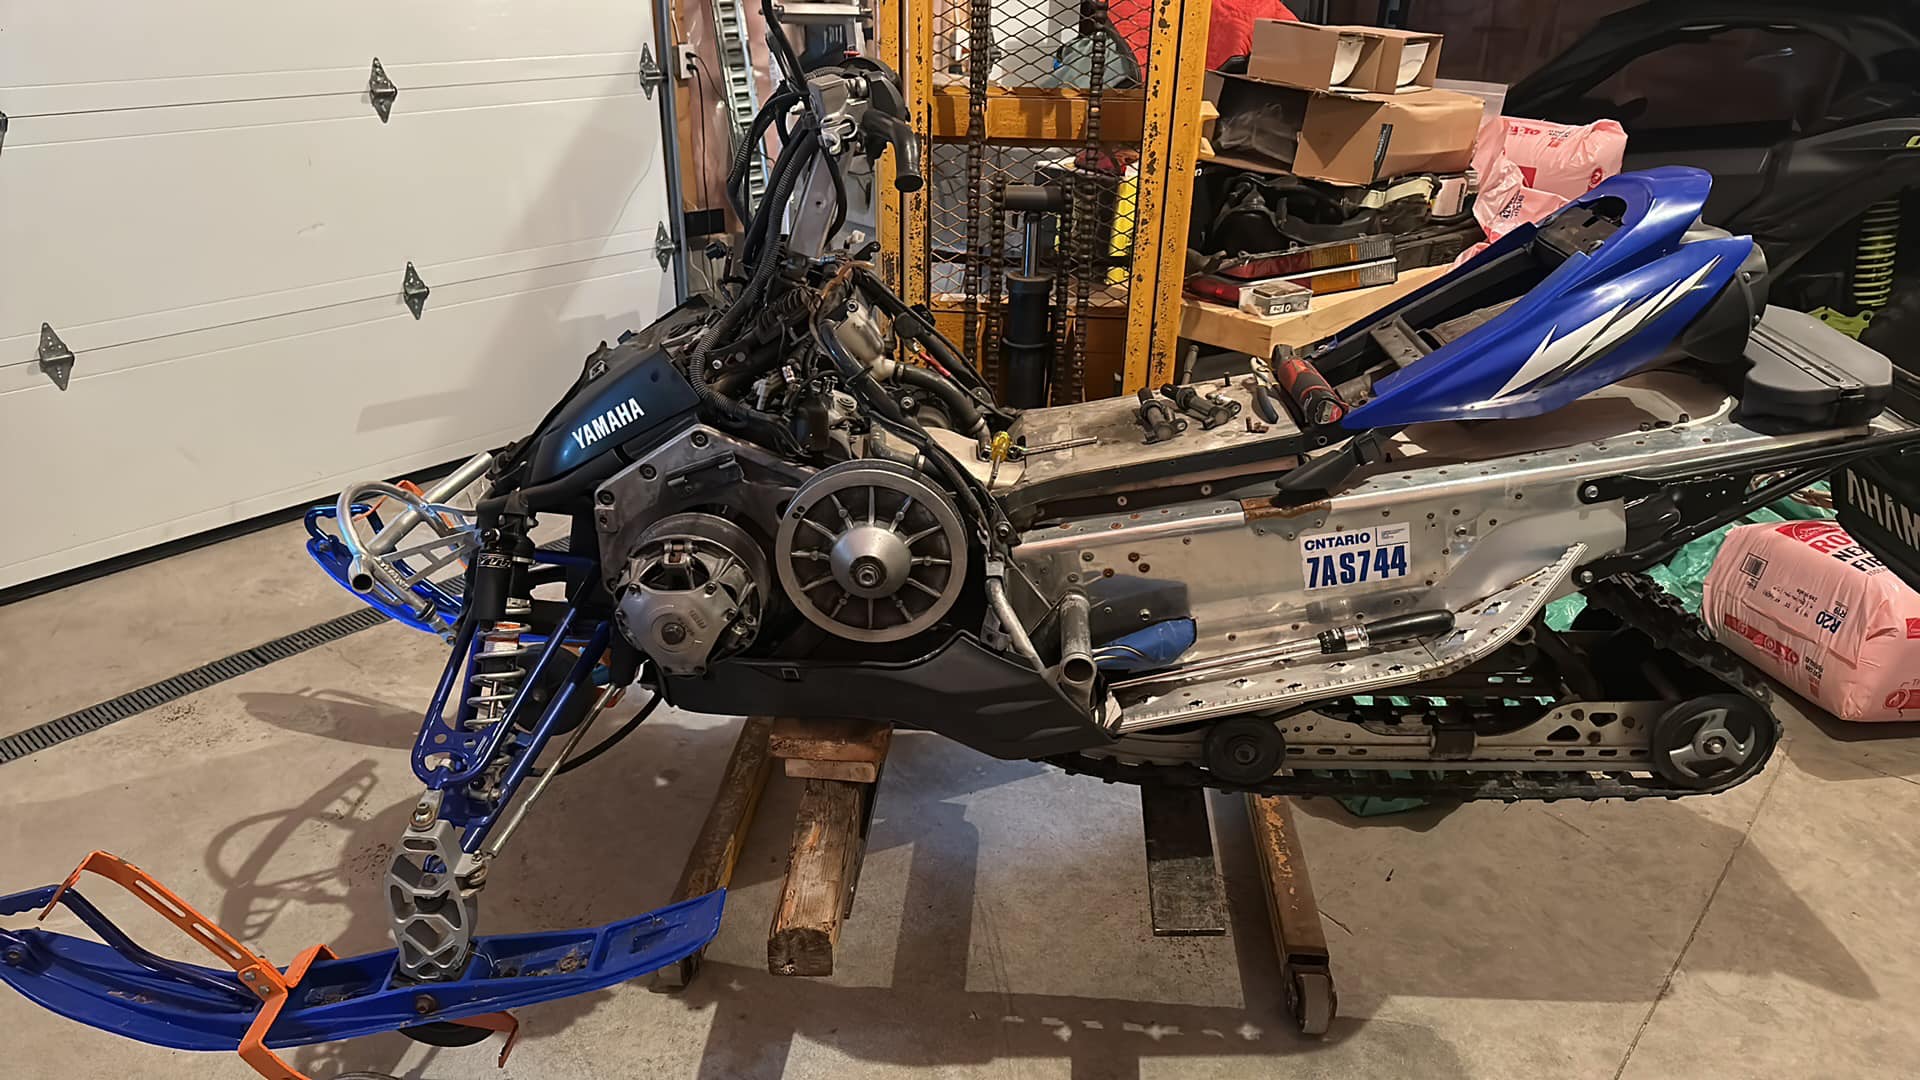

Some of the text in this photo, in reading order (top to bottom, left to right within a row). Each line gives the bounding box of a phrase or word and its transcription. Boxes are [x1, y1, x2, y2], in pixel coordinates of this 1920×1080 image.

[571, 397, 645, 449] YAMAHA
[1304, 532, 1371, 551] ONTARIO
[1808, 531, 1852, 554] RO
[1306, 545, 1407, 589] 7AS744
[1815, 610, 1841, 634] R20
